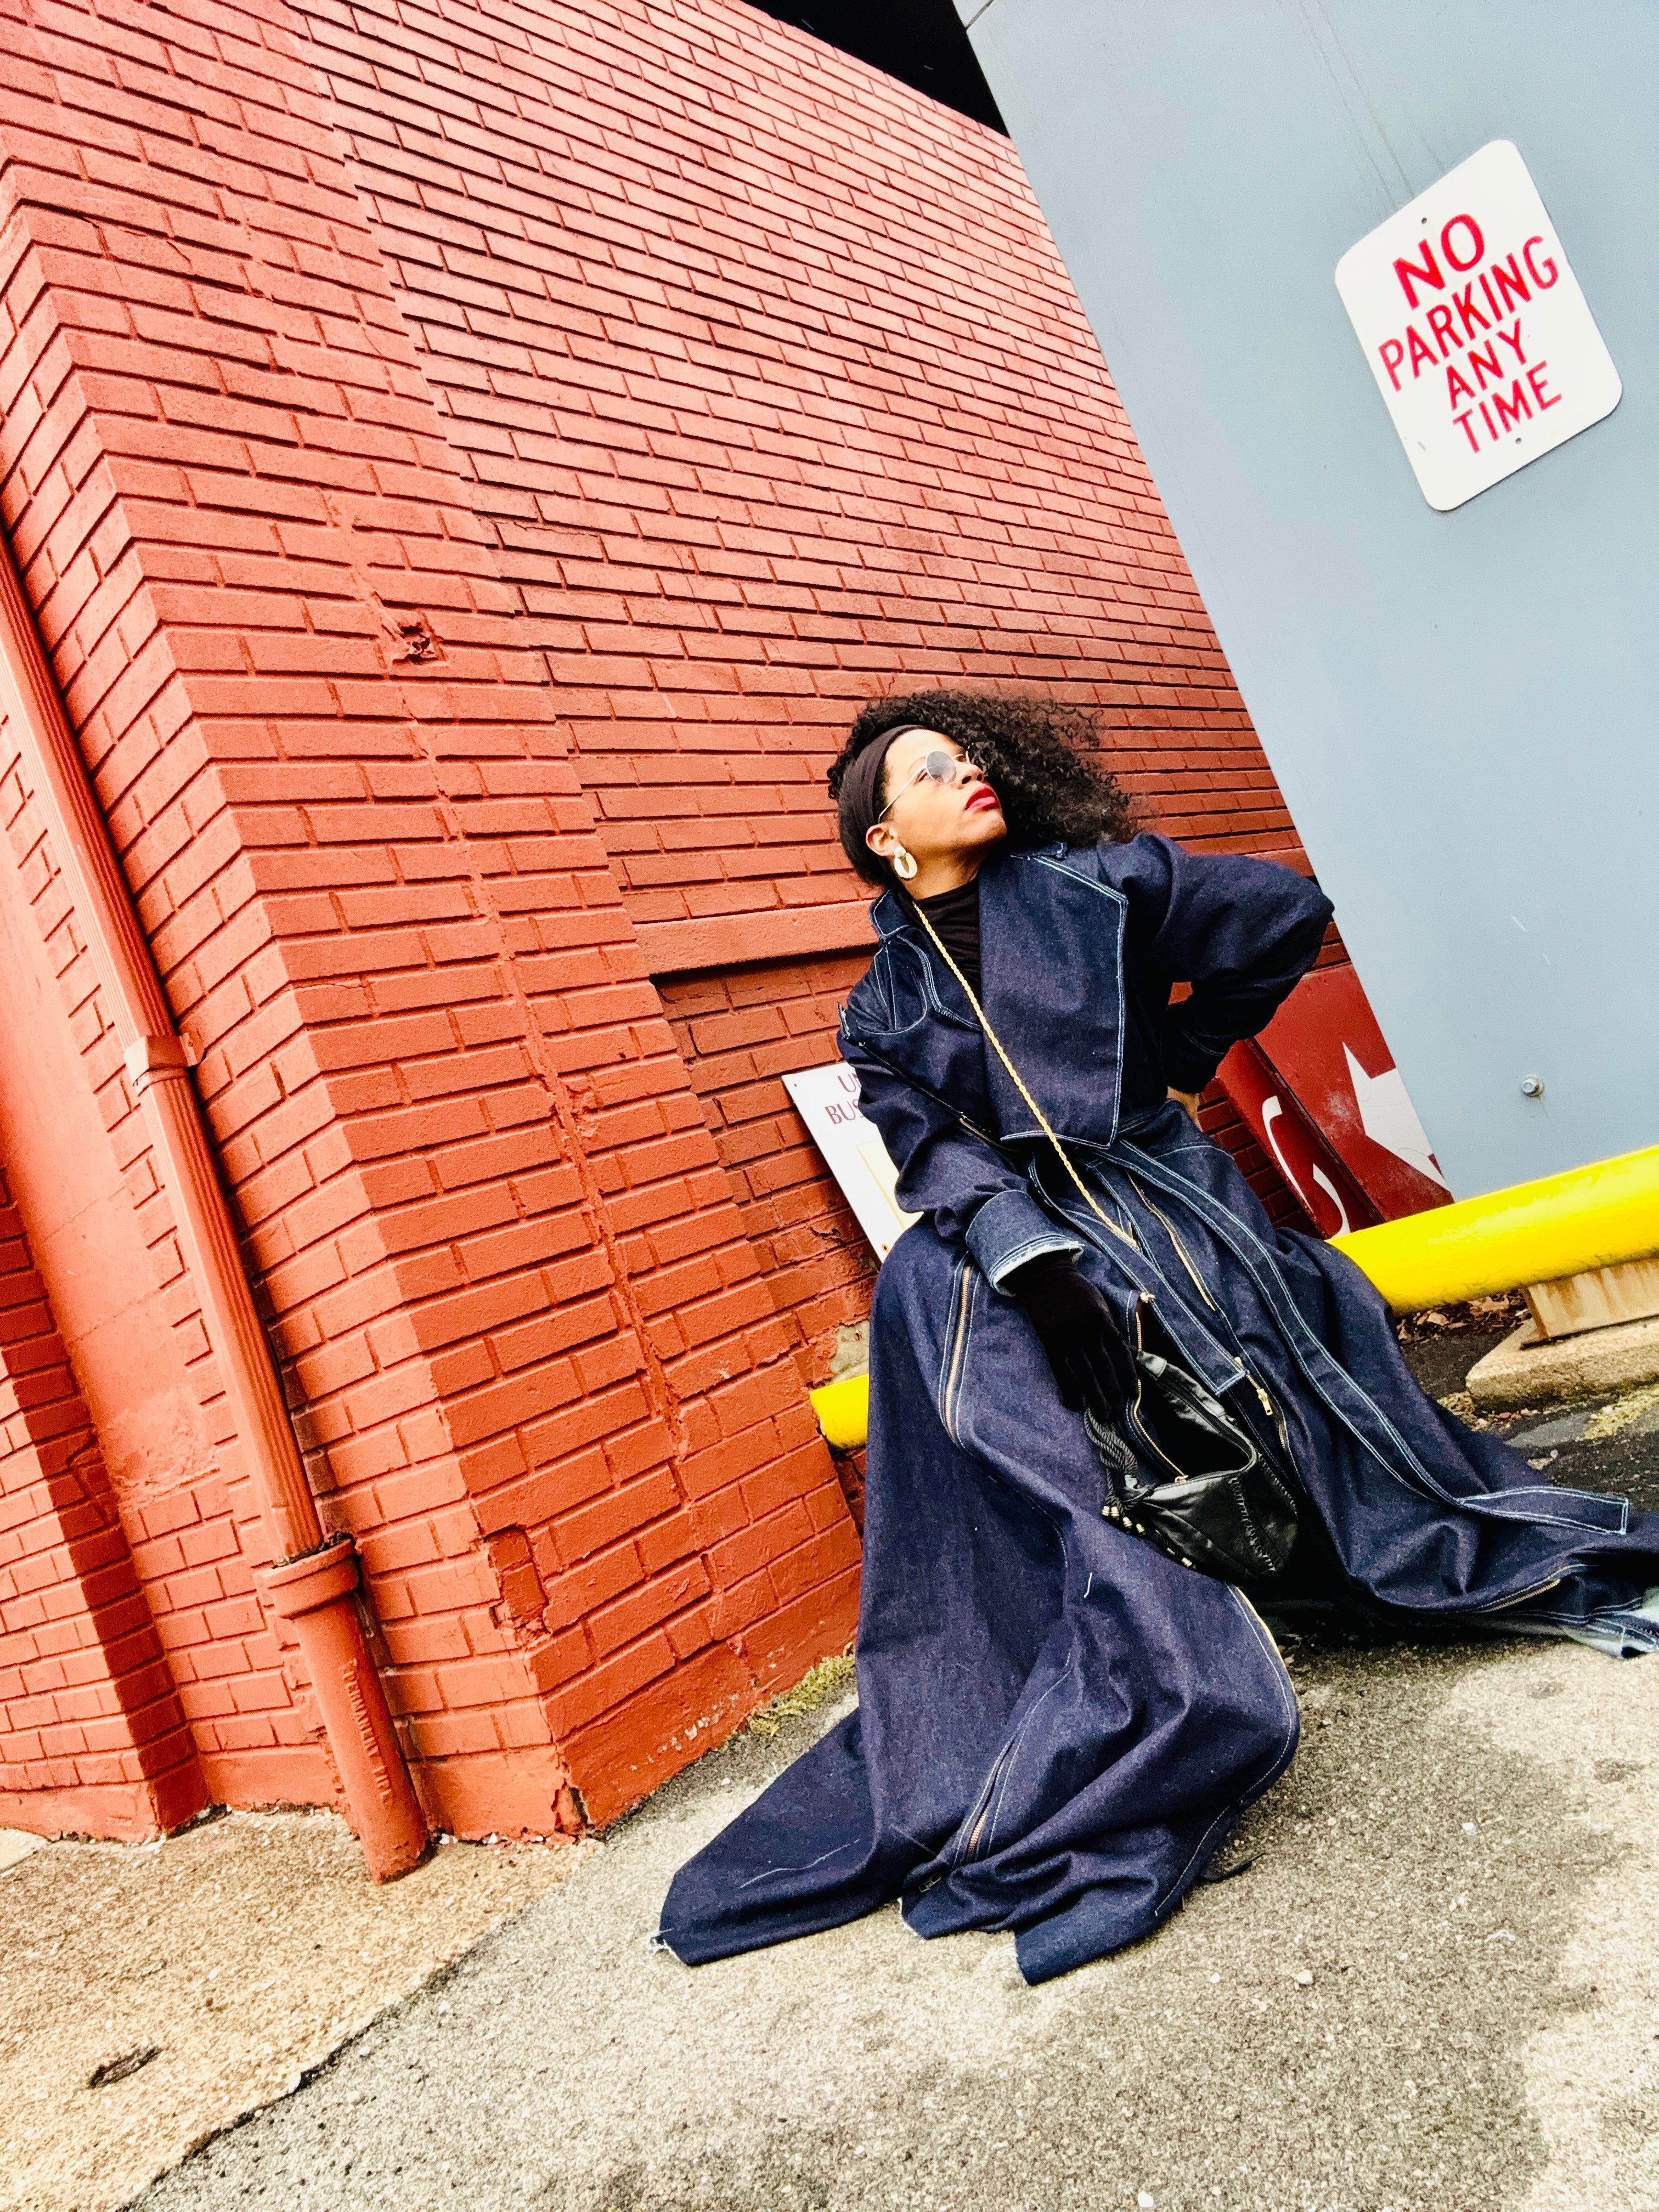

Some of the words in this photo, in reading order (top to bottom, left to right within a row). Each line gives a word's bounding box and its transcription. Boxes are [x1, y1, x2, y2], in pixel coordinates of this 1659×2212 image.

[1392, 213, 1485, 311] NO
[1378, 235, 1559, 392] PARKING
[1446, 318, 1527, 411] ANY
[1452, 360, 1562, 454] TIME
